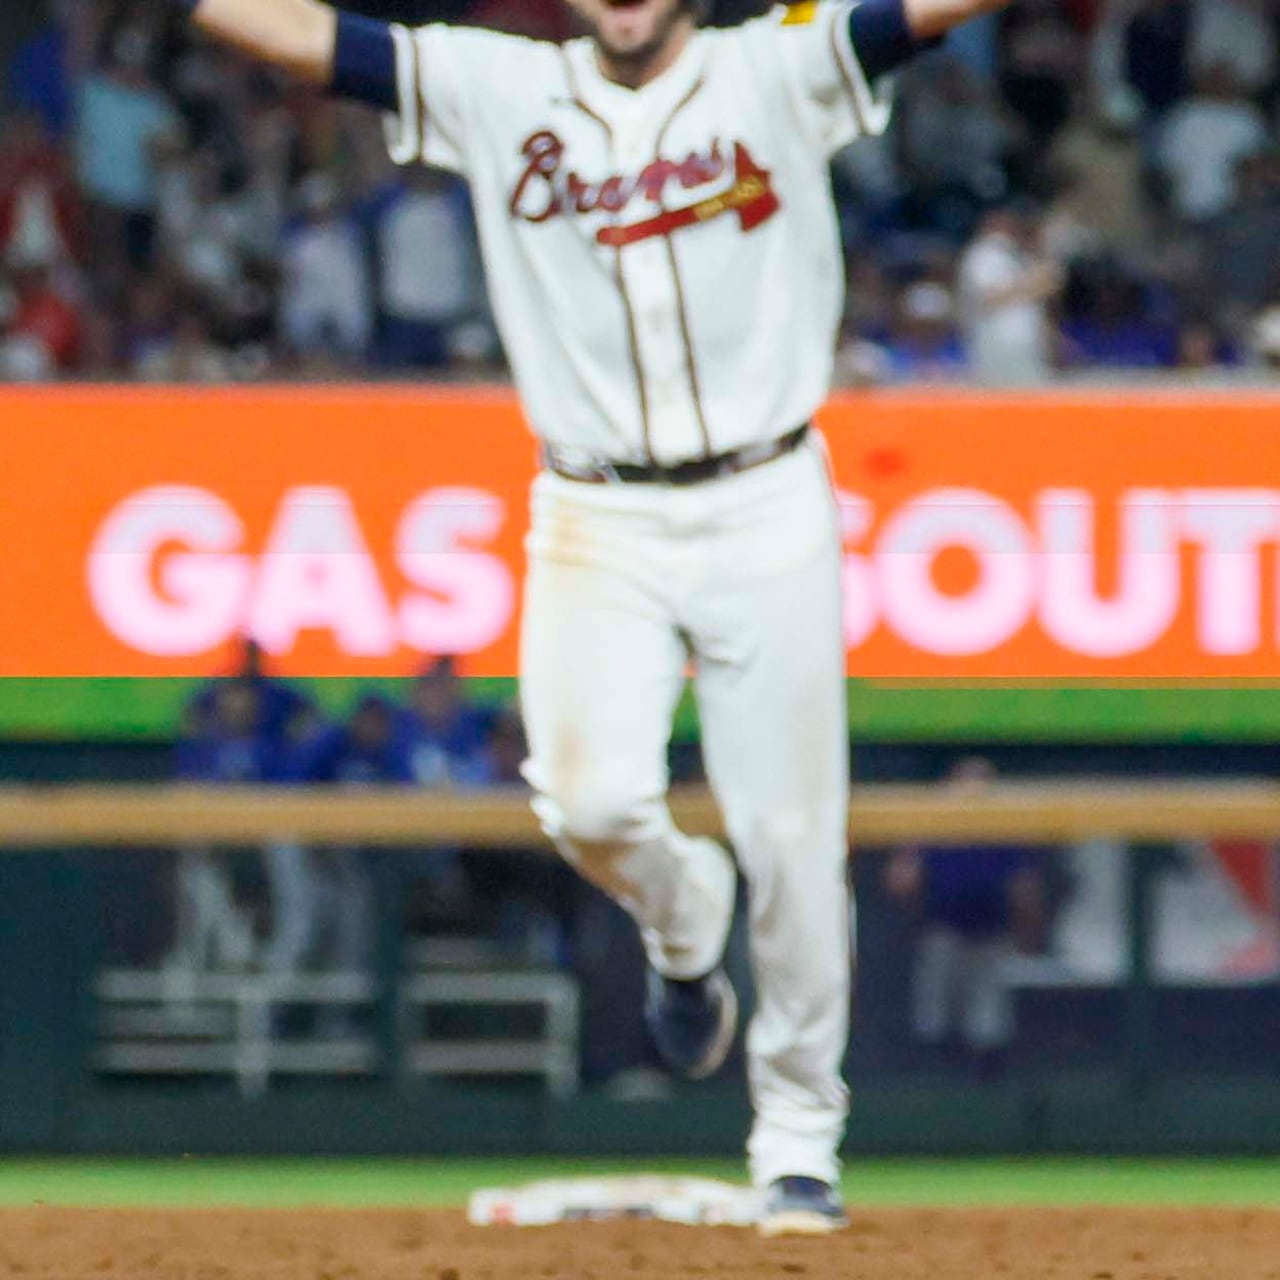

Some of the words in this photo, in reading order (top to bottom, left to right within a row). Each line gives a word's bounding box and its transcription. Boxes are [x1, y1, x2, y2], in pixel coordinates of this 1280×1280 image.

[509, 129, 723, 223] Braves
[86, 481, 517, 658] GAS
[838, 484, 1280, 658] OUT
